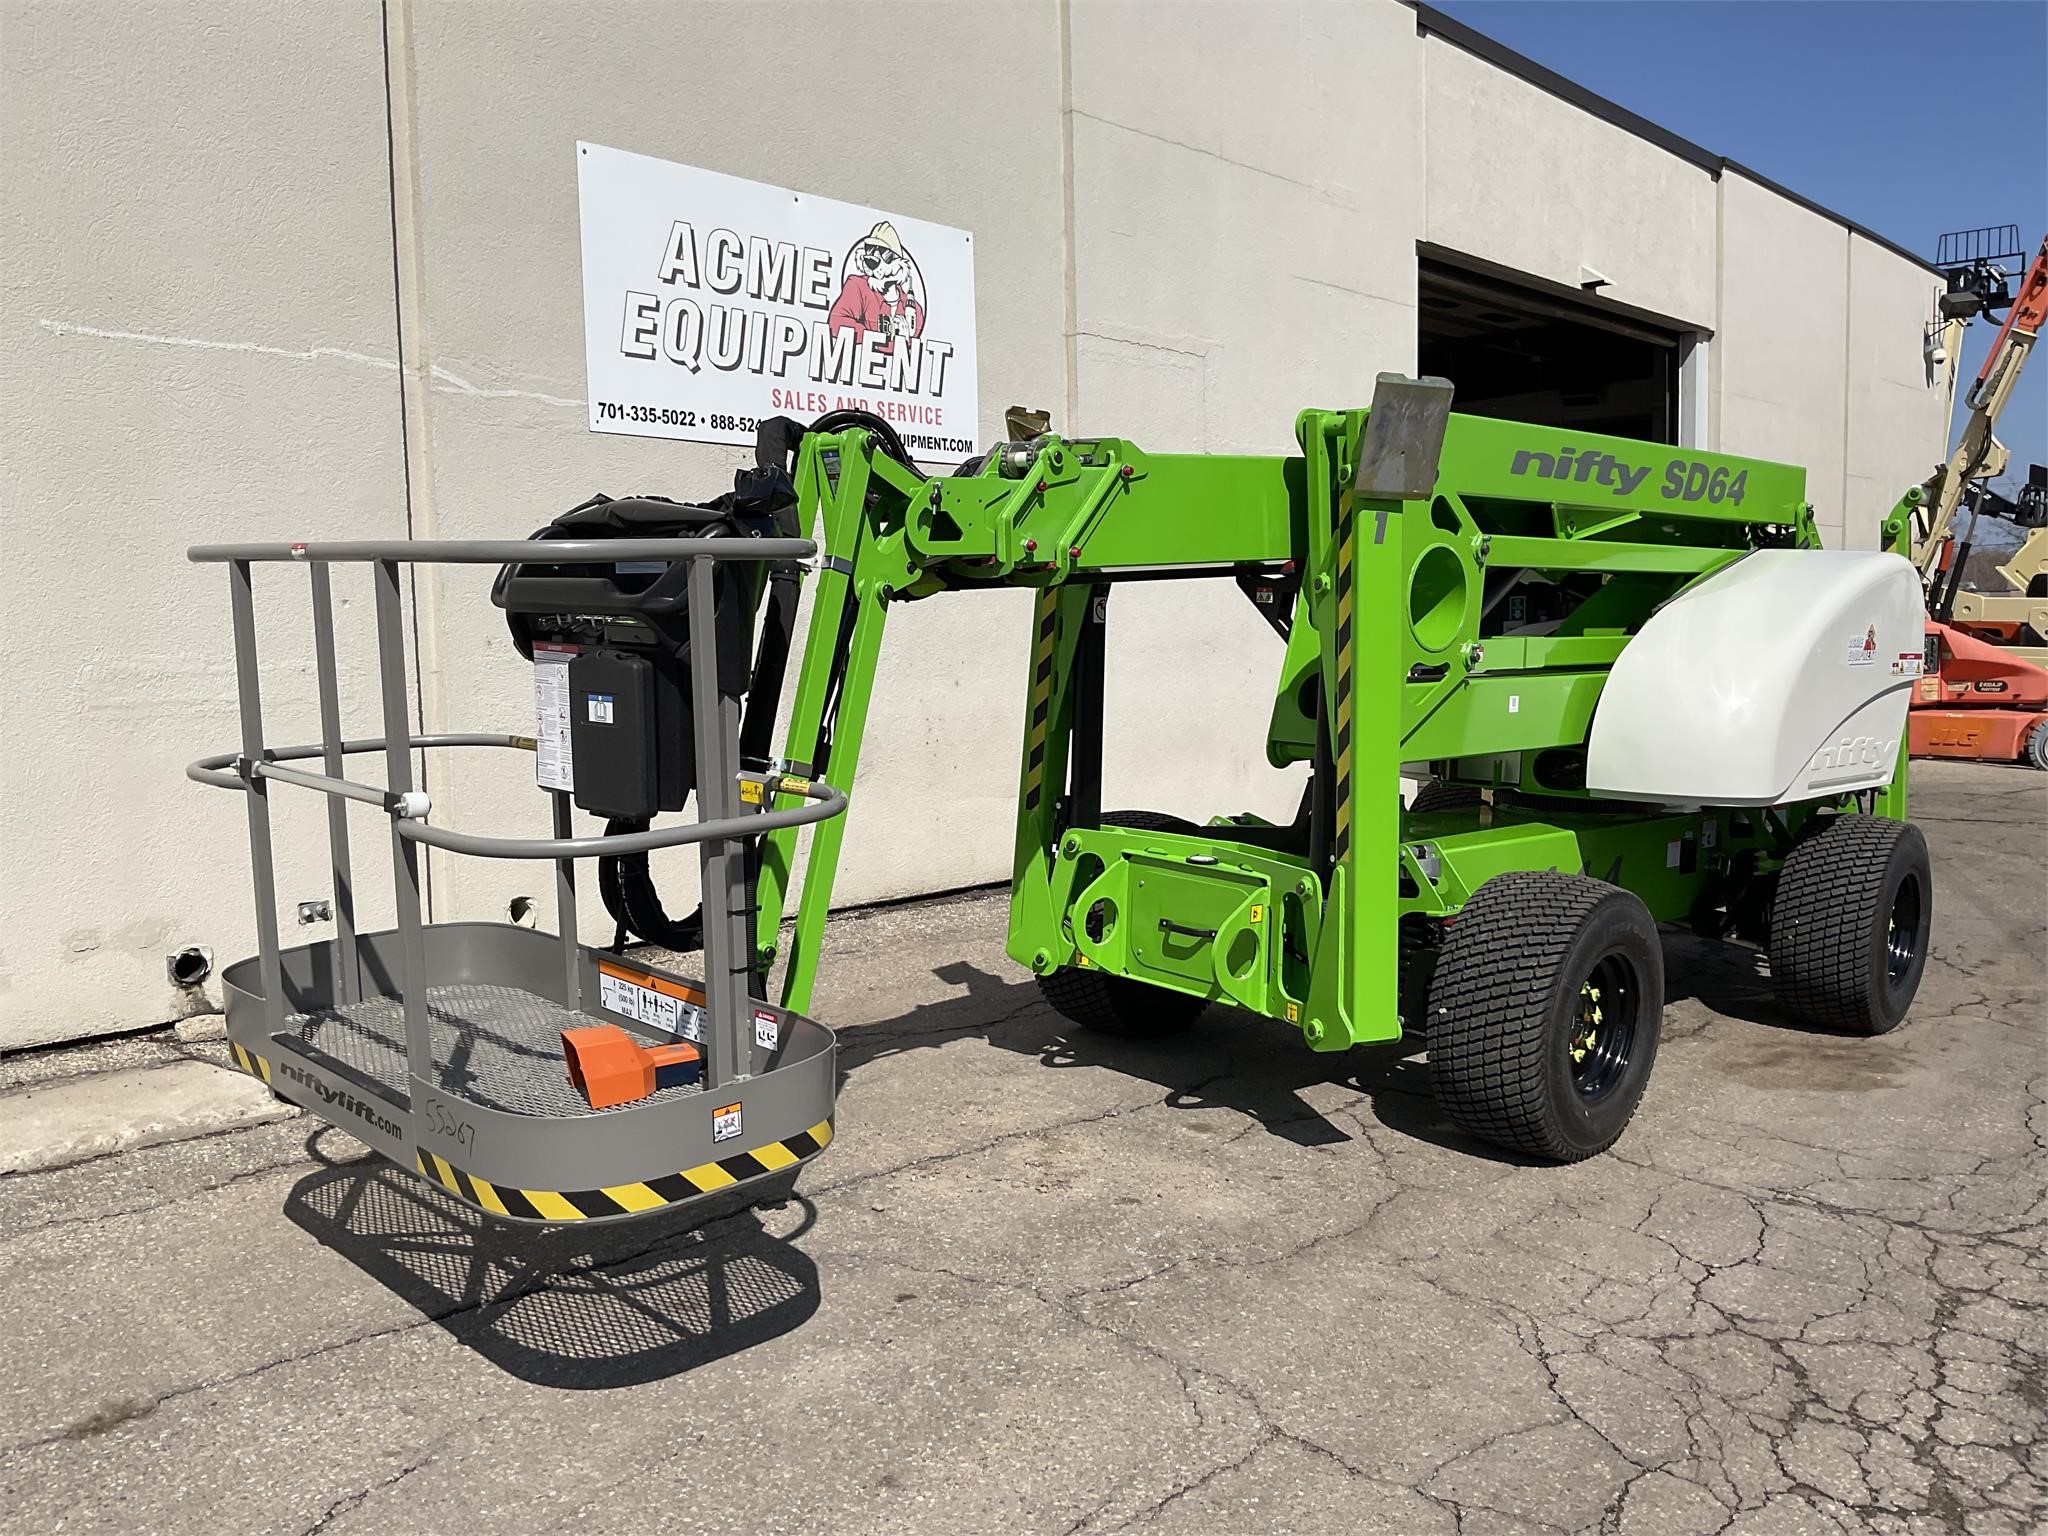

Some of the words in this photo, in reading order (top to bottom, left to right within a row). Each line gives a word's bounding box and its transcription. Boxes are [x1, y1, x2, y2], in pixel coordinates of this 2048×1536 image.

[658, 220, 832, 311] ACME
[620, 290, 953, 397] EQUIPMENT
[598, 402, 696, 427] 701-335-5022
[772, 388, 827, 413] SALES
[836, 396, 869, 412] AND
[877, 400, 942, 426] SERVICE
[1510, 447, 1652, 496] nifty
[1661, 459, 1748, 507] SD64
[1810, 736, 1897, 770] nifty
[621, 1006, 633, 1017] MAX
[280, 1061, 403, 1141] niftylift.com
[425, 1098, 475, 1158] 55267
